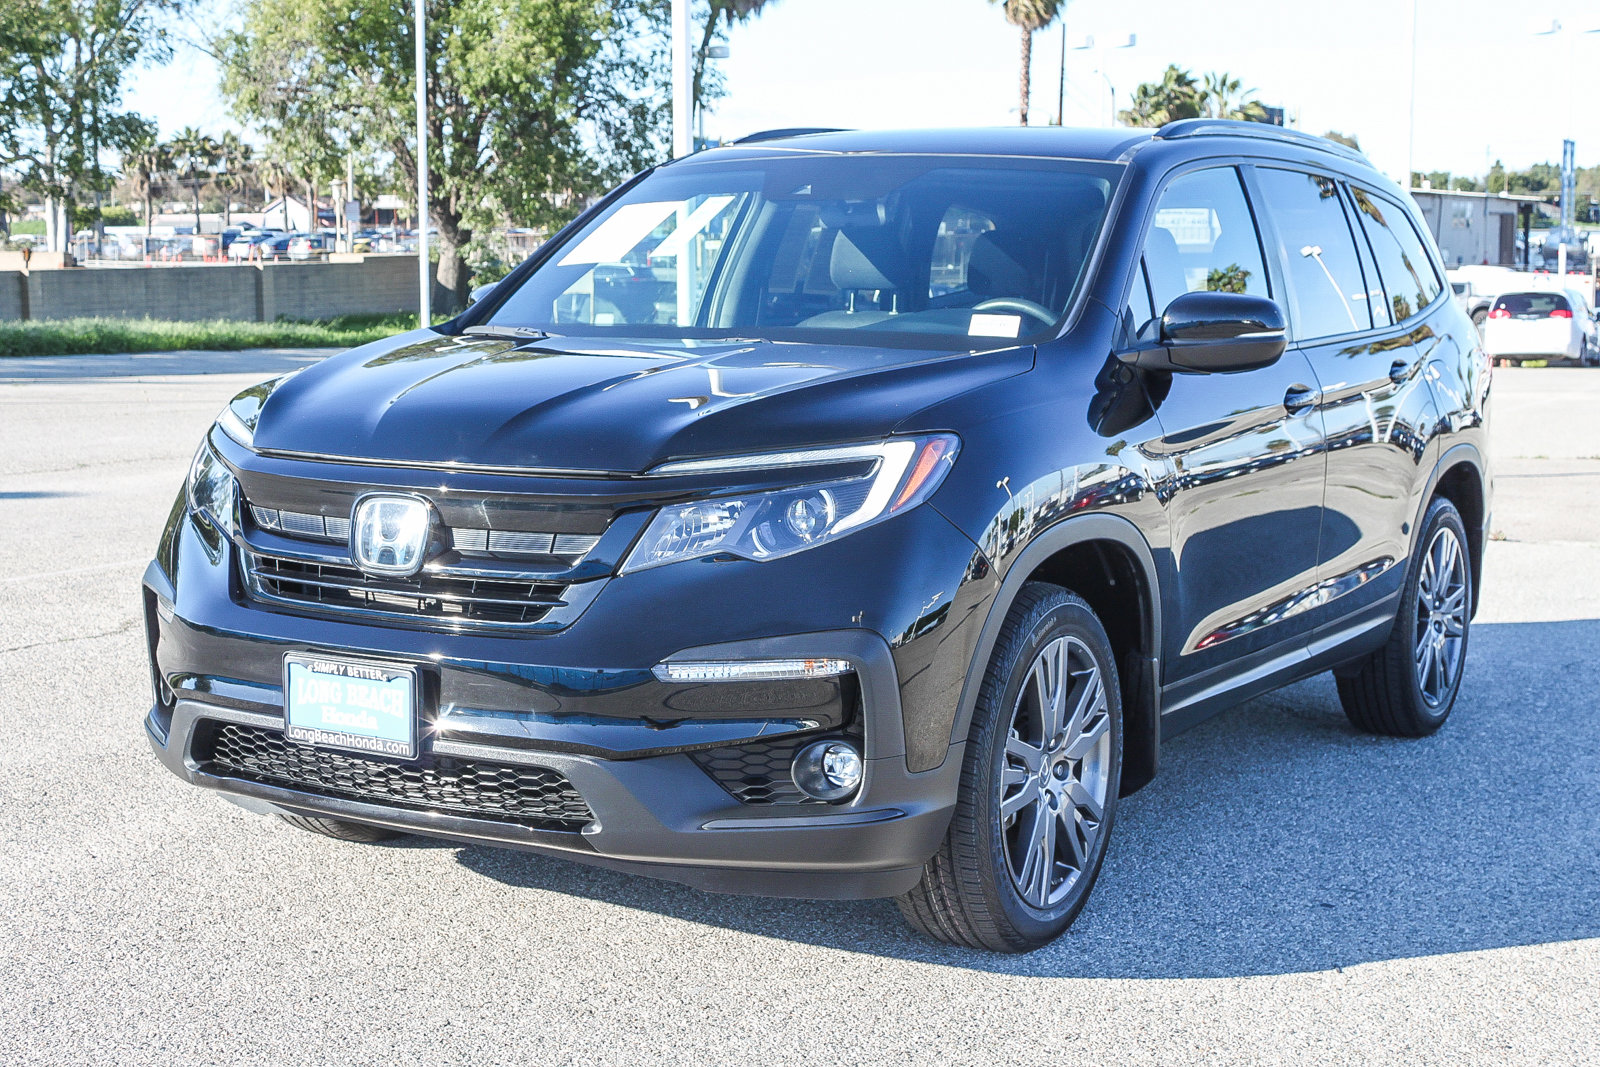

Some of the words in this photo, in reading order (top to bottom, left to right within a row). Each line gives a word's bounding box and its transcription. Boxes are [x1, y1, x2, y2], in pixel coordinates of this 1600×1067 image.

[313, 662, 346, 675] SIMPLY
[347, 666, 383, 680] BETTER
[297, 677, 343, 705] LONG
[346, 683, 405, 719] BEACH
[321, 705, 379, 730] Honda
[288, 724, 410, 756] LongBeachHonda.com
